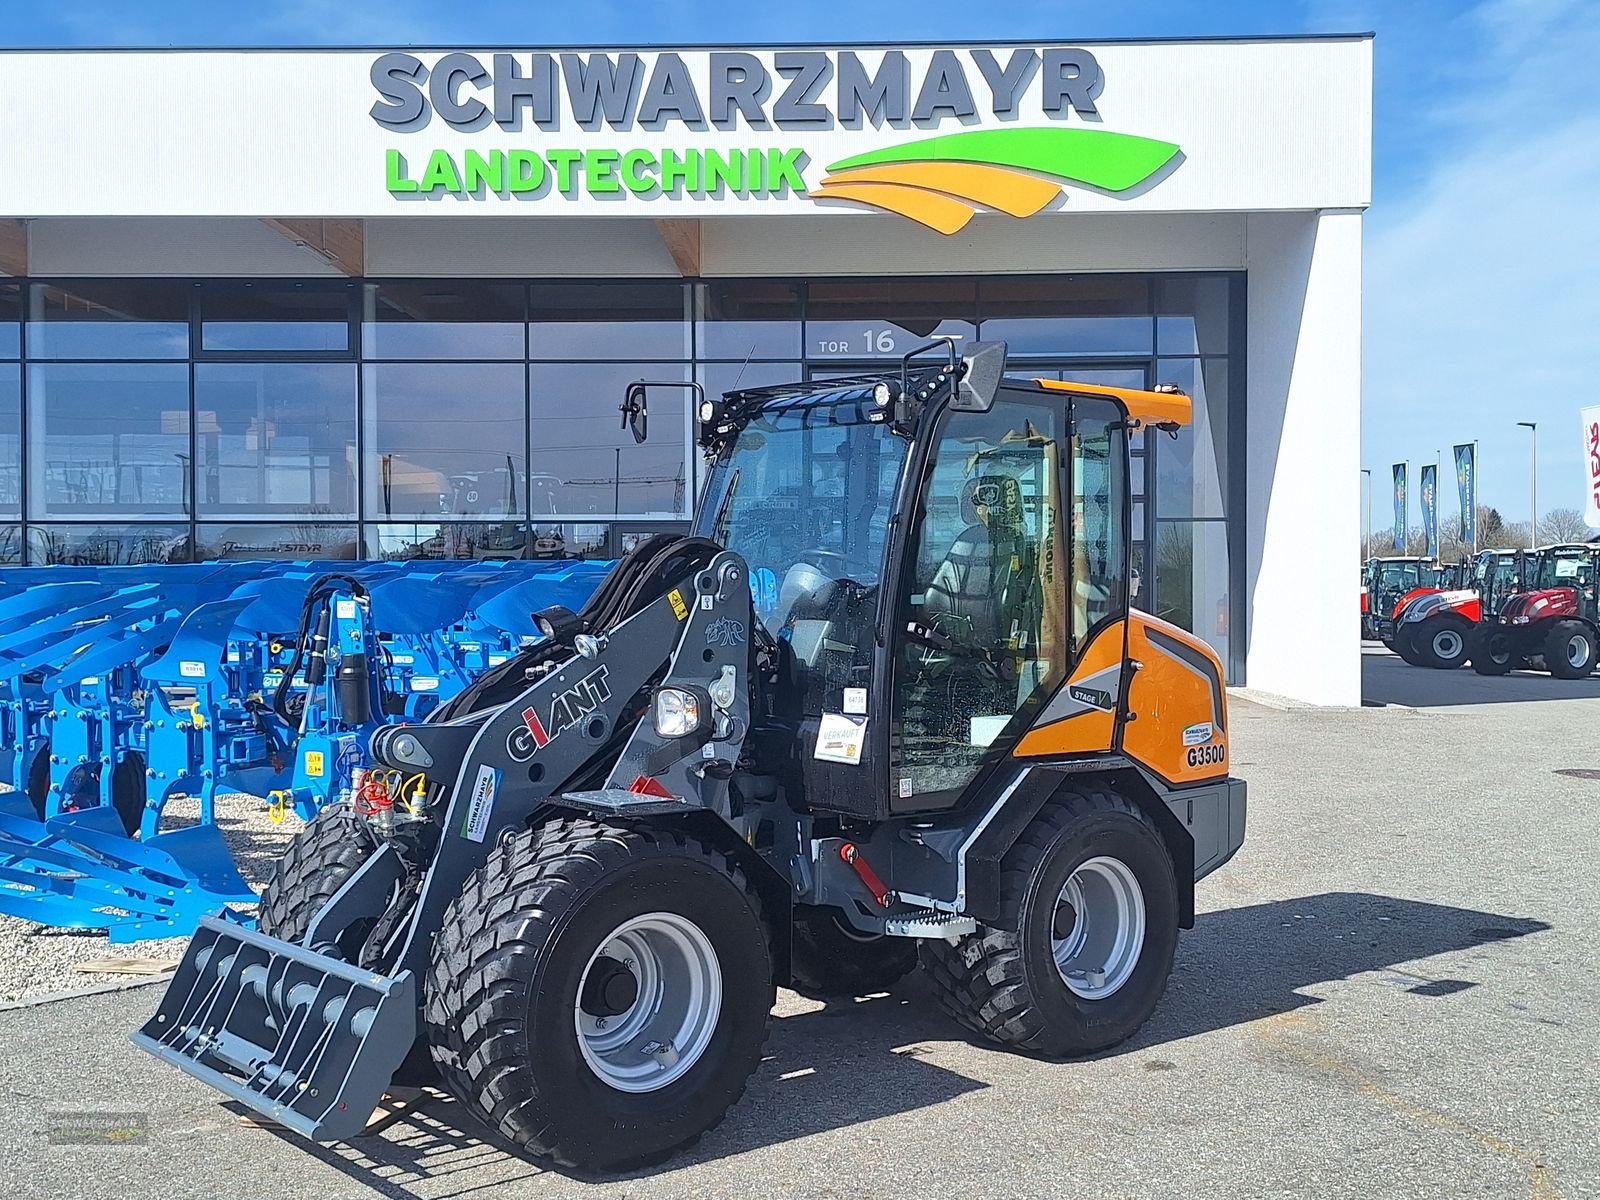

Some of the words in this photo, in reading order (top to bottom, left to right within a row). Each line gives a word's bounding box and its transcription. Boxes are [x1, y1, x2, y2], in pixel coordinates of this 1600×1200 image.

[370, 47, 1103, 130] SCHWARZMAYR
[386, 148, 807, 198] LANDTECHNIK
[819, 341, 848, 352] TOR
[863, 330, 895, 352] 16
[285, 543, 321, 552] STEYR
[1074, 690, 1096, 704] STAGE
[506, 664, 612, 762] GIANT
[824, 728, 860, 740] VERKAUFT
[1187, 743, 1225, 767] G3500
[468, 776, 488, 834] SCHWARZMAYR
